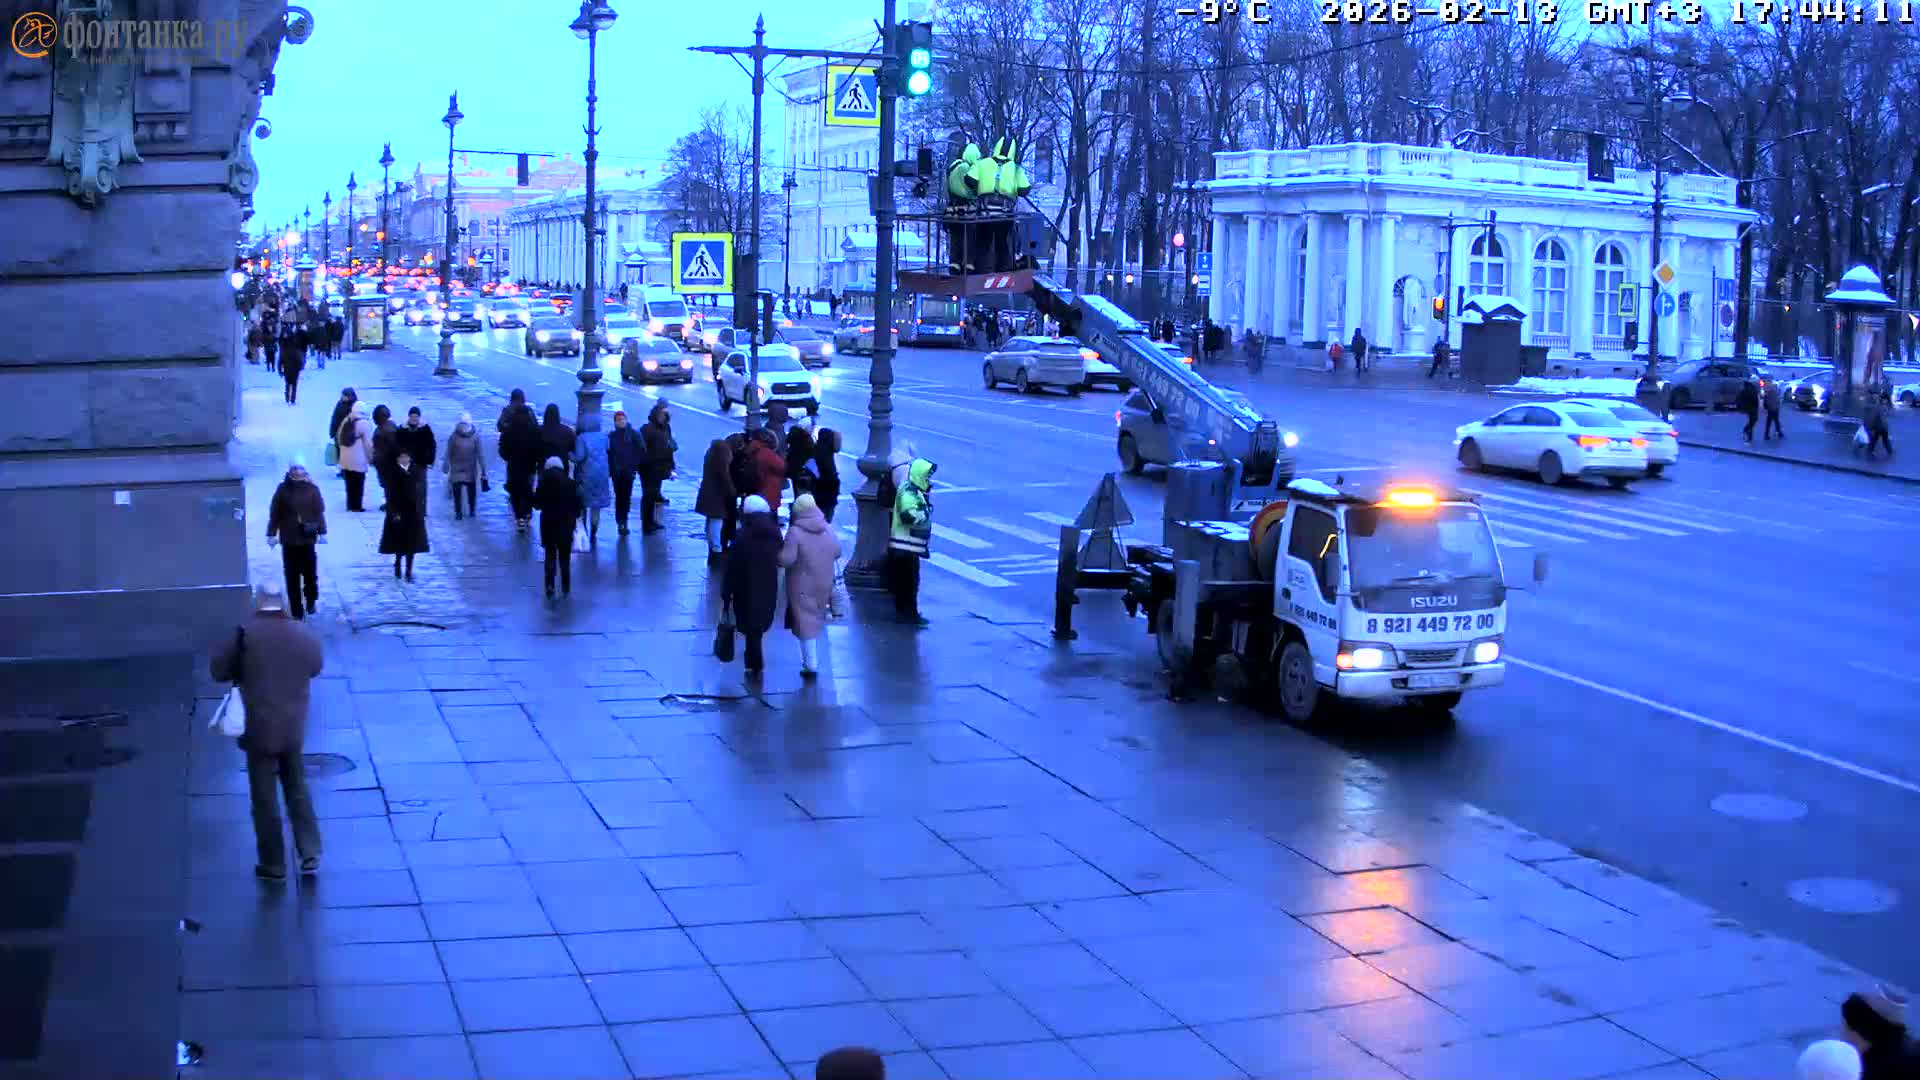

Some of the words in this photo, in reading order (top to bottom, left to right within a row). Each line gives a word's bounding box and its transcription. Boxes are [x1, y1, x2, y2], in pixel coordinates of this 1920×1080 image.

[1410, 594, 1458, 608] ISUZU
[1366, 618, 1378, 634] 8
[1383, 617, 1412, 633] 921
[1416, 615, 1449, 632] 449
[1453, 614, 1473, 631] 72
[1476, 613, 1495, 629] 00
